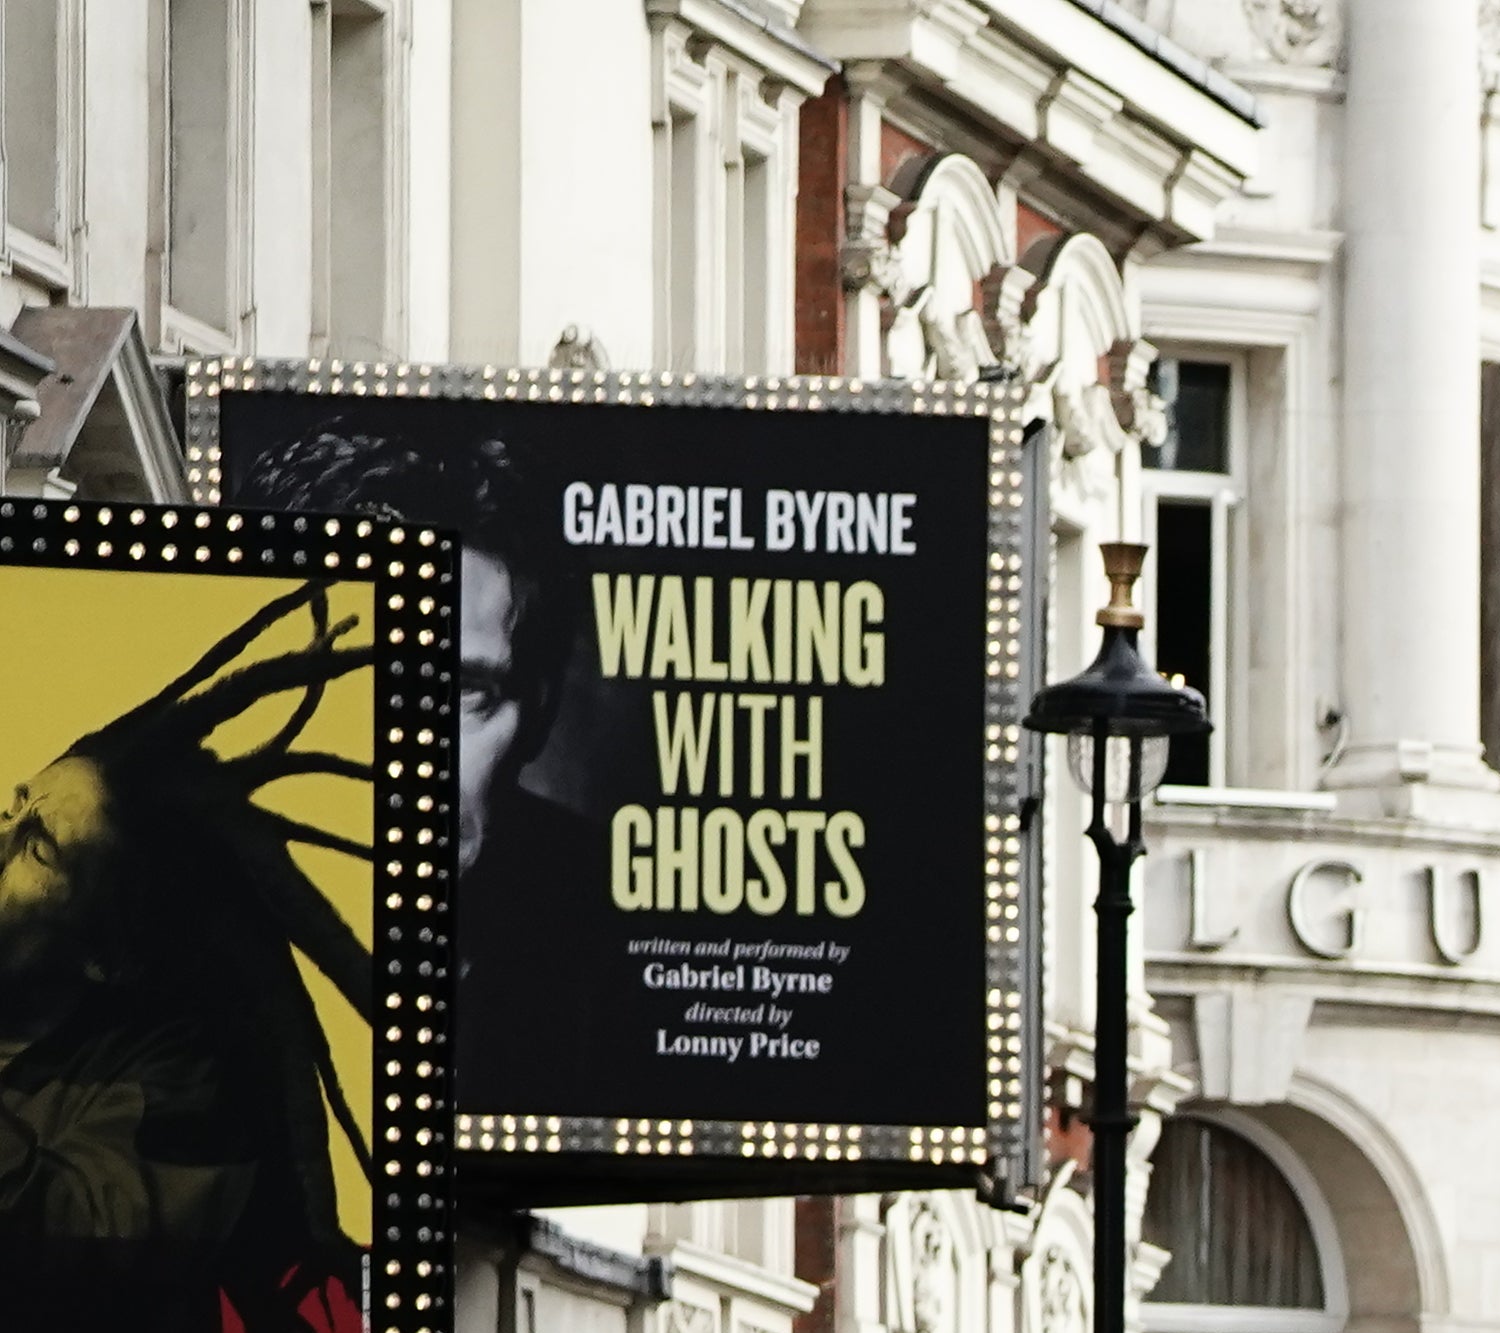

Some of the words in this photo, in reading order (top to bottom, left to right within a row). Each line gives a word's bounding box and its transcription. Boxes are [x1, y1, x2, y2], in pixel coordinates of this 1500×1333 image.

[563, 482, 755, 549] GABRIEL
[765, 489, 917, 554] BYRNE
[592, 573, 885, 687] WALKING
[653, 691, 822, 800] WITH
[611, 804, 866, 918] GHOSTS
[628, 937, 691, 957] written
[695, 940, 729, 957] and
[733, 940, 824, 964] performed
[828, 942, 851, 963] by
[643, 963, 745, 992] Gabriel
[751, 966, 834, 999] Byrne
[685, 1002, 764, 1024] directed
[768, 1004, 793, 1028] by
[657, 1029, 744, 1062] Lonny
[750, 1031, 821, 1060] Price
